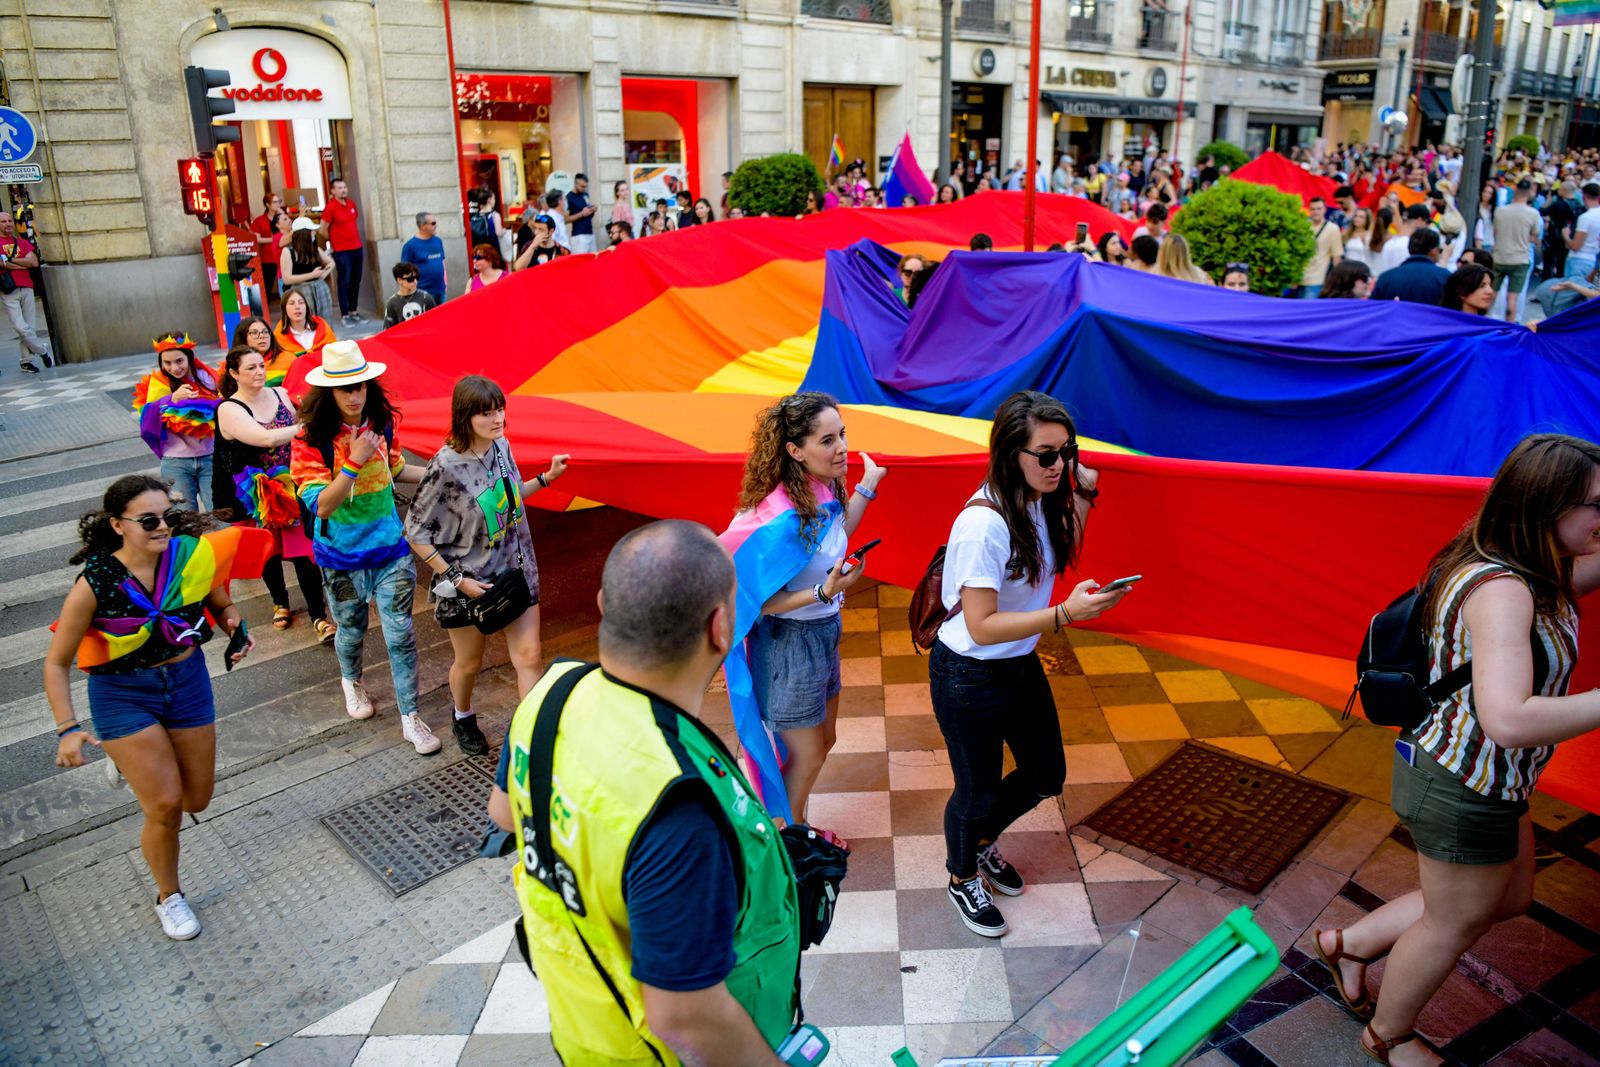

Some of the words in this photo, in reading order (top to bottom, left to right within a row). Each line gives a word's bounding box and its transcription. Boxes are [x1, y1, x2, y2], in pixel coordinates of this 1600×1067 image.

[1045, 65, 1067, 85] LA
[1337, 72, 1370, 85] TOUS
[221, 84, 323, 103] vodafone
[192, 188, 211, 211] 16
